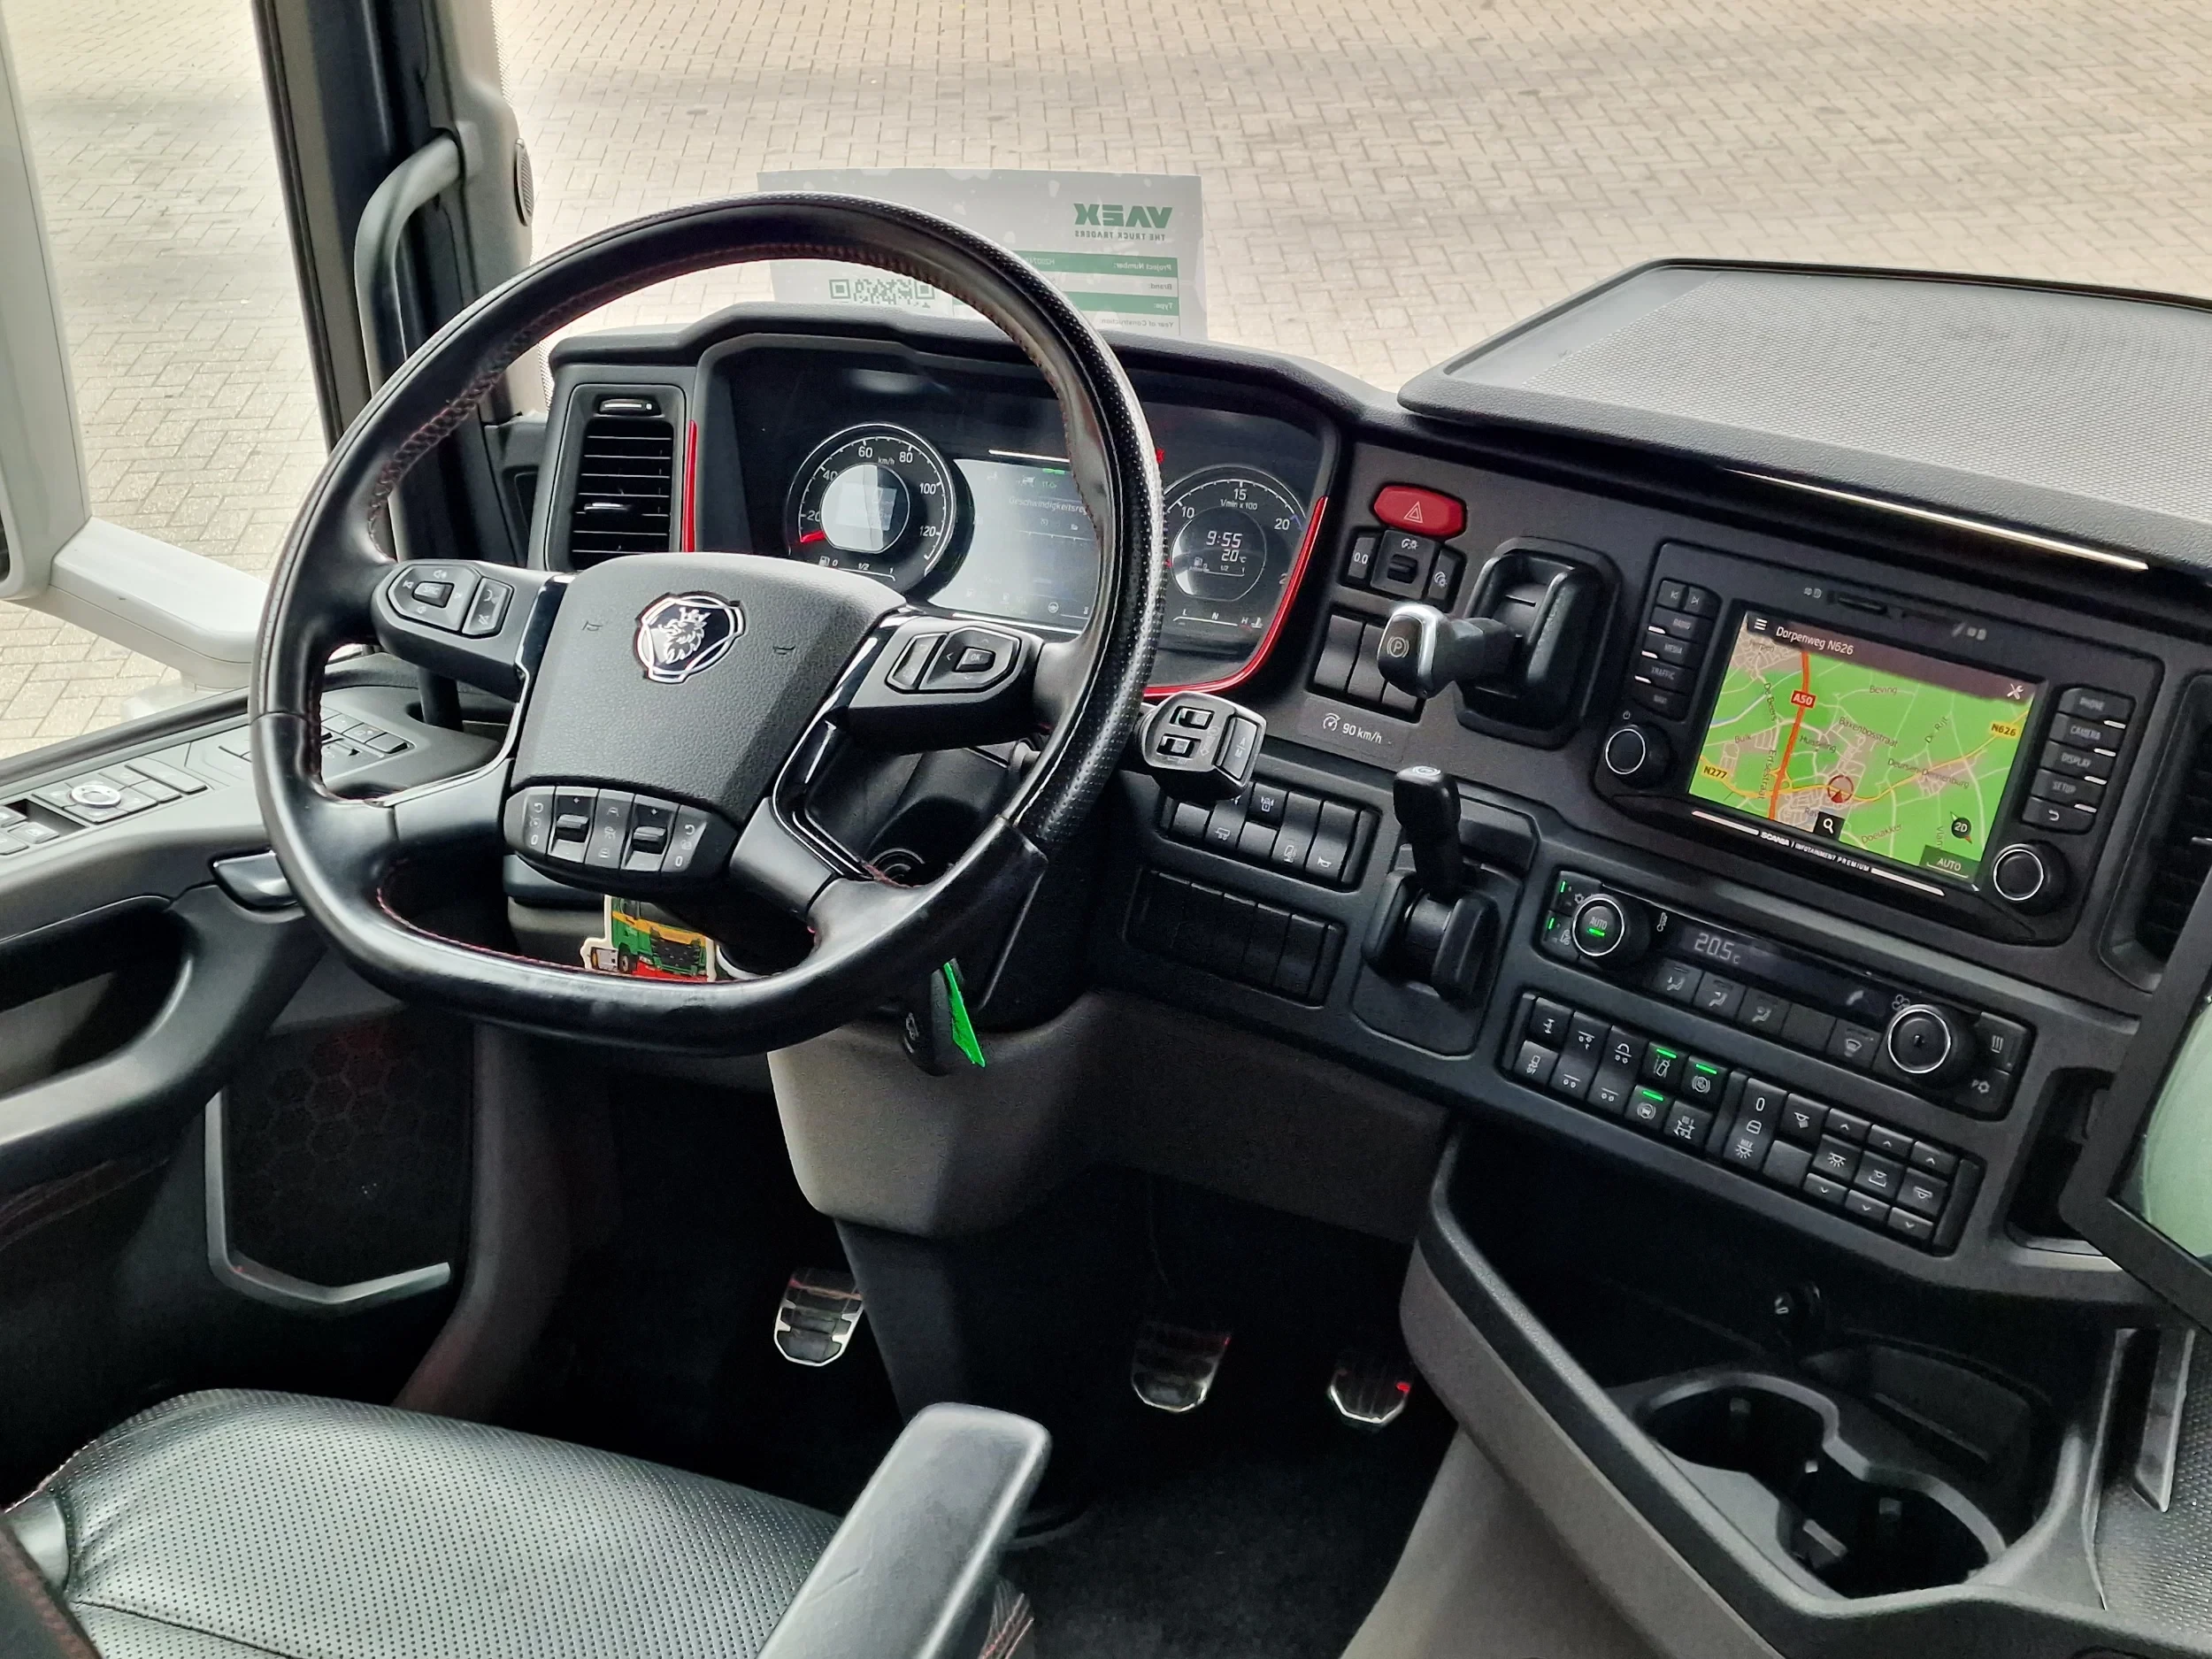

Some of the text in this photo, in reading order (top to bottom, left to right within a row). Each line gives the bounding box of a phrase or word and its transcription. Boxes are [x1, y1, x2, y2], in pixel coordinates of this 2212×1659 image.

[858, 447, 873, 458] 60
[899, 451, 913, 463] 80
[878, 457, 895, 465] km/h
[823, 470, 838, 481] 40
[919, 482, 937, 495] 100
[1233, 488, 1248, 501] 15
[1181, 506, 1195, 518] 10
[1274, 518, 1290, 530] 20
[919, 526, 937, 537] 120
[1206, 531, 1243, 549] 9:55
[1221, 549, 1239, 562] 20
[1776, 626, 1855, 656] Dorpenweg N626
[1651, 666, 1675, 680] TRAFFIC
[1793, 694, 1814, 706] A50
[1342, 723, 1382, 744] 90 km/h
[1991, 723, 2017, 737] N626
[2061, 753, 2092, 768] DISPLAY
[1703, 765, 1728, 780] N277
[2052, 780, 2077, 794] SETUP
[1954, 822, 1968, 833] 2D
[1760, 831, 1870, 872] SCANIA INFOTAINMENT PREMIUM
[1938, 857, 1962, 872] AUTO
[1589, 916, 1608, 930] AUTO
